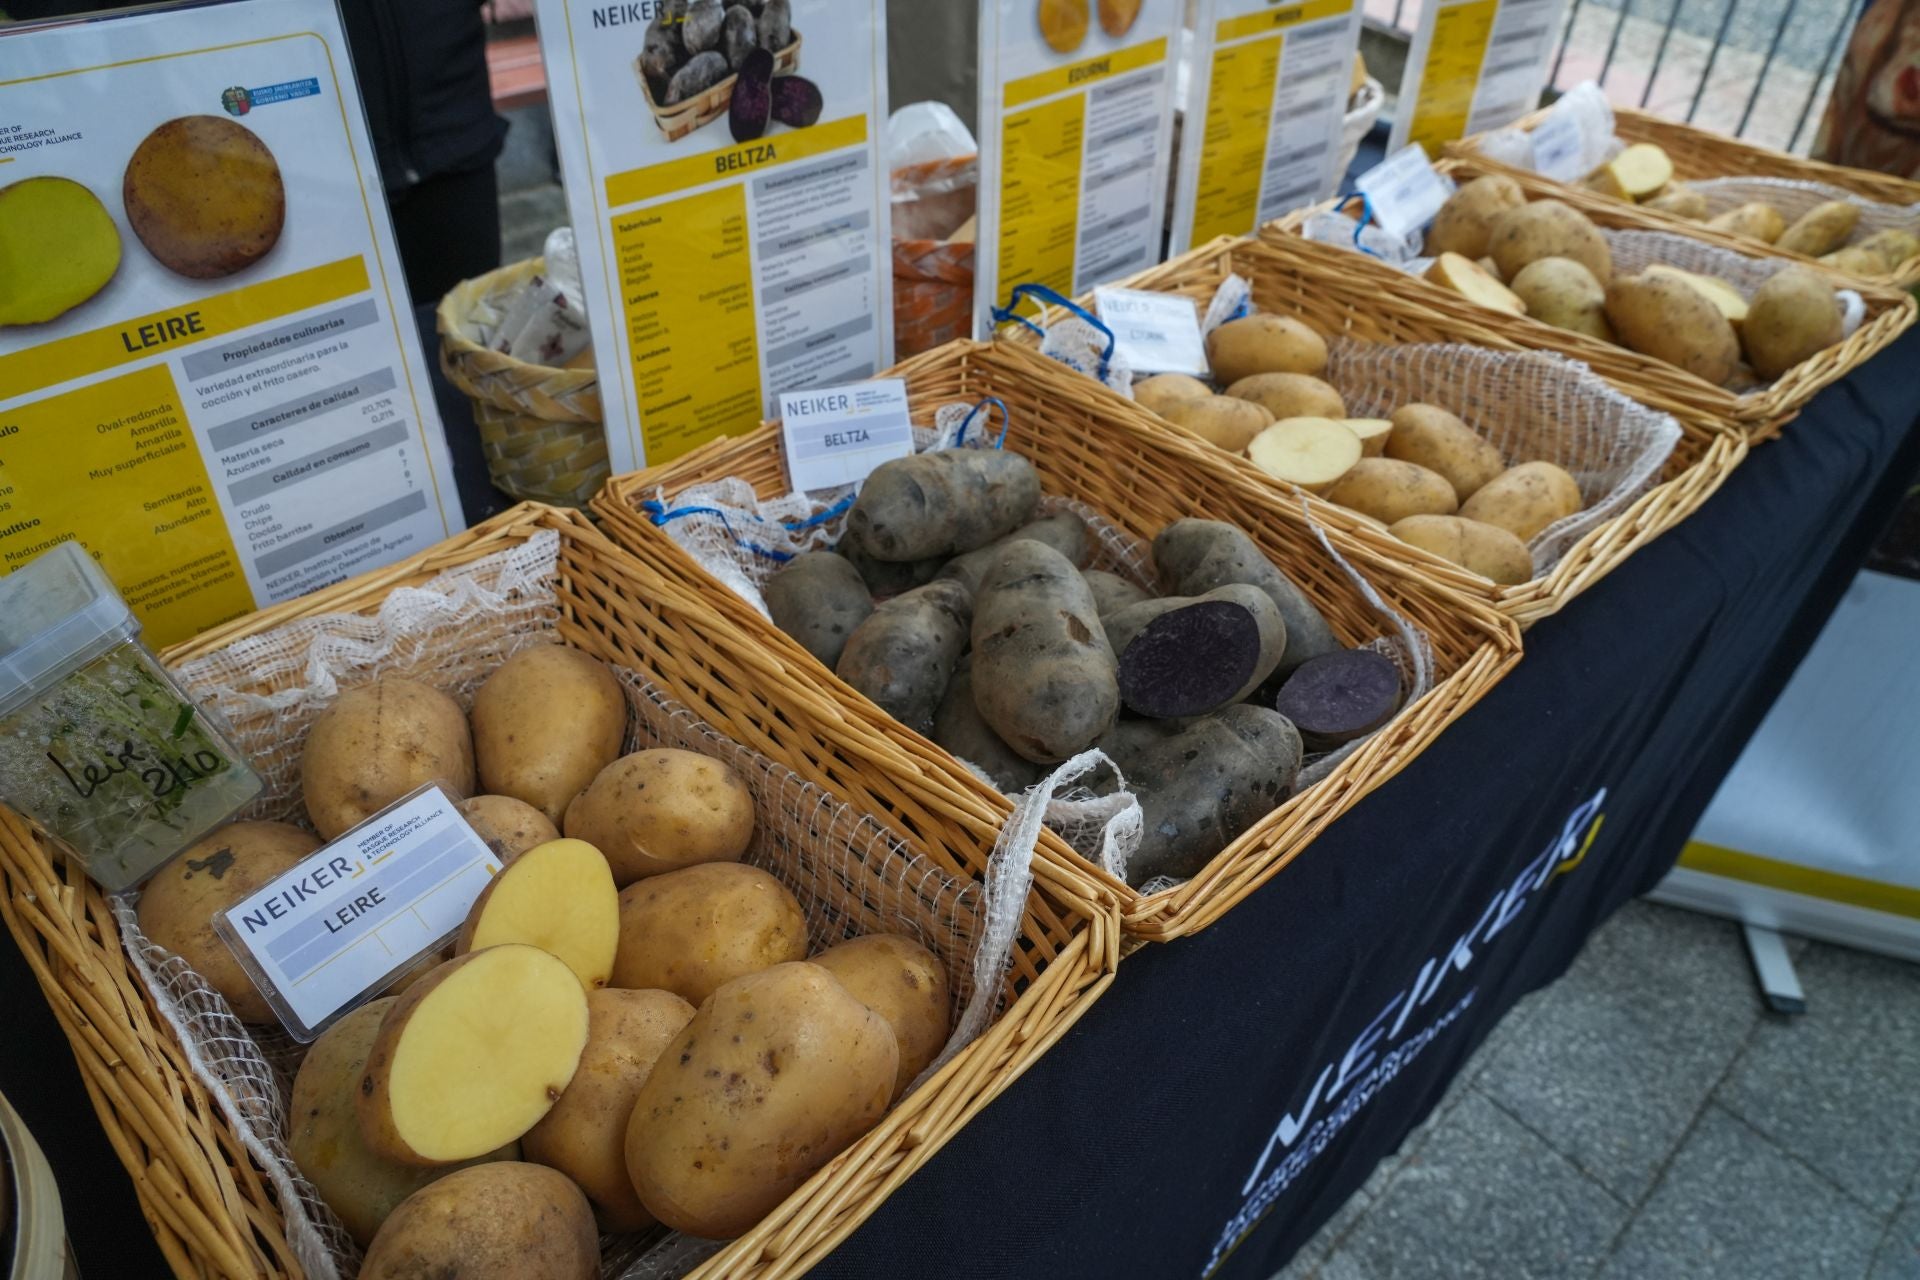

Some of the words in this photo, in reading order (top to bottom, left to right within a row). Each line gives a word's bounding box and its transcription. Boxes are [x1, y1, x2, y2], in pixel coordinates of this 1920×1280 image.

[592, 0, 665, 29] NEIKER
[0, 140, 43, 153] CHNOLOGY
[45, 132, 82, 145] ALLIANCE
[11, 125, 22, 133] OF
[14, 128, 55, 142] RESEARCH
[716, 143, 776, 173] BELTZA
[122, 312, 206, 352] LEIRE
[222, 333, 291, 362] Propiedades
[292, 318, 345, 341] culinarias
[196, 374, 244, 396] Variedad
[246, 352, 315, 382] extraordinaria
[316, 345, 338, 360] para
[339, 341, 349, 351] la
[201, 390, 244, 410] cocción
[244, 387, 251, 397] y
[252, 382, 262, 392] el
[263, 375, 285, 388] frito
[787, 394, 849, 417] NEIKER
[96, 402, 173, 434] Oval-redonda
[250, 404, 307, 431] Caracteres
[308, 398, 322, 412] de
[322, 386, 360, 407] calidad
[130, 416, 178, 438] Amarilla
[135, 428, 182, 450] Amarilla
[824, 429, 870, 447] BELTZA
[89, 466, 113, 480] Muy
[115, 441, 187, 472] superficiales
[220, 446, 260, 466] Materia
[261, 438, 285, 452] seca
[272, 463, 312, 485] Calidad
[313, 458, 326, 469] en
[326, 440, 371, 463] consumo
[186, 496, 207, 510] Alto
[240, 502, 271, 520] Crudo
[154, 508, 212, 535] Abundante
[244, 514, 273, 531] Chips
[248, 522, 283, 542] Cocido
[323, 521, 365, 544] Obtentor
[252, 537, 276, 552] Frito
[370, 535, 381, 546] de
[170, 550, 227, 577] numerosos
[190, 560, 231, 581] blancas
[145, 596, 174, 612] Porte
[357, 830, 384, 848] MEMBER
[384, 823, 393, 832] OF
[362, 835, 388, 854] BASQUE
[388, 816, 422, 839] RESEARCH
[372, 828, 413, 856] TECHNOLOGY
[414, 809, 444, 830] ALLIANCE
[242, 856, 353, 934] NEIKER
[323, 887, 386, 934] LEIRE
[1241, 787, 1608, 1196] NEIKER
